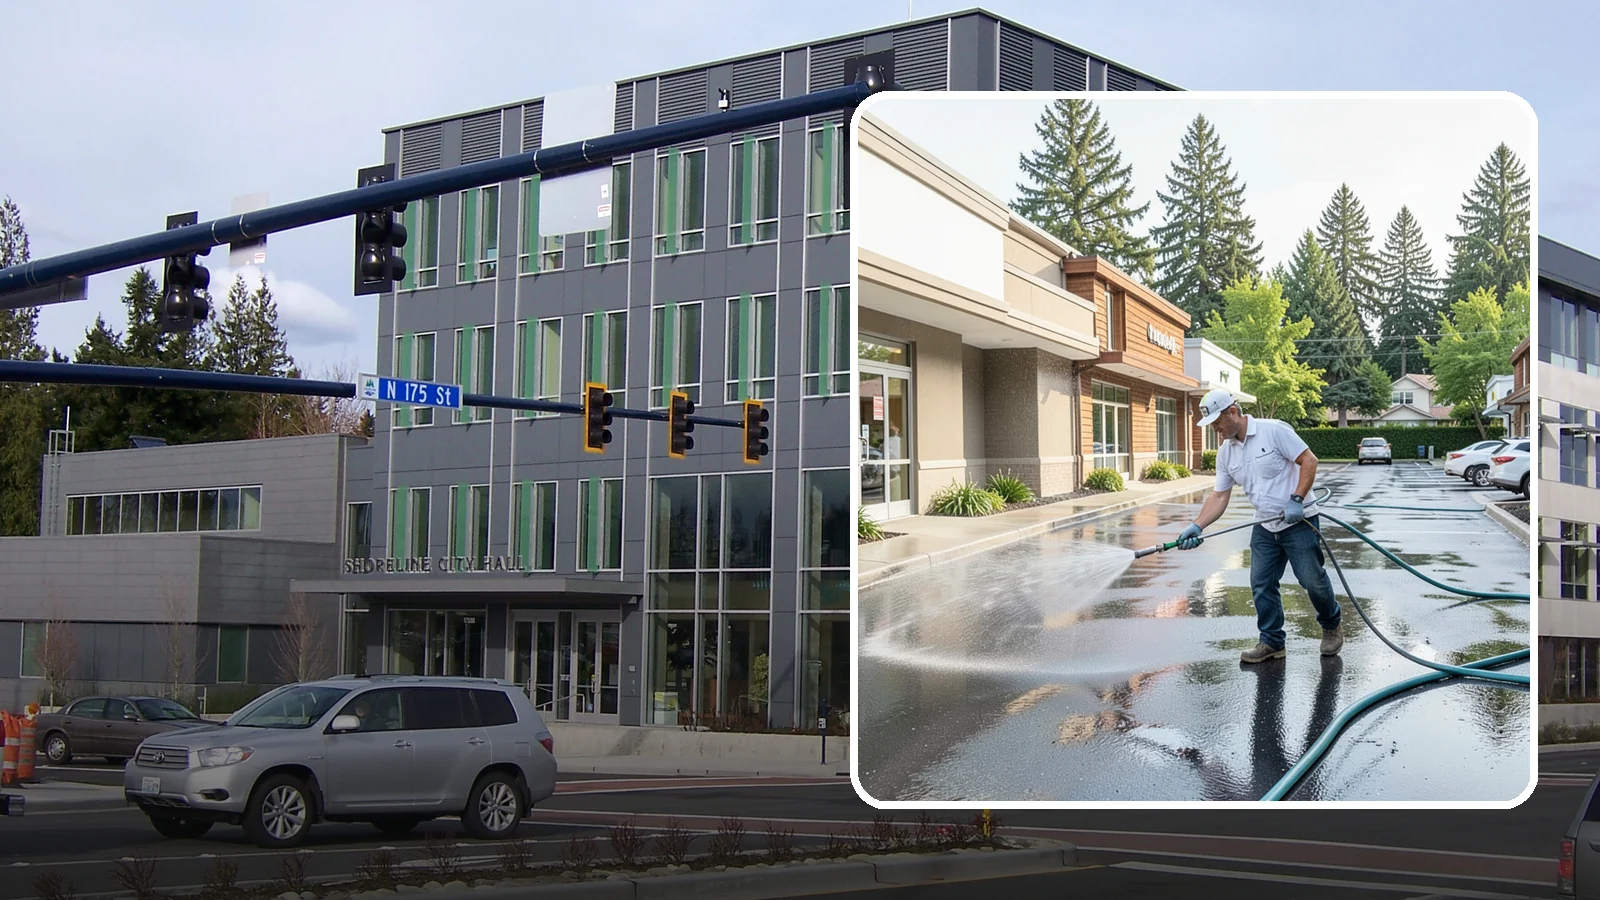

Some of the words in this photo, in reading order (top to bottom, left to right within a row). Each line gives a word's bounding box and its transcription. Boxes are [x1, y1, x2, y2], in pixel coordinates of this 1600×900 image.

[387, 380, 396, 400] N
[405, 382, 427, 403] 175
[436, 386, 451, 406] St
[344, 556, 432, 574] SHORELINE
[438, 556, 475, 572] CITY
[483, 555, 526, 571] HALL
